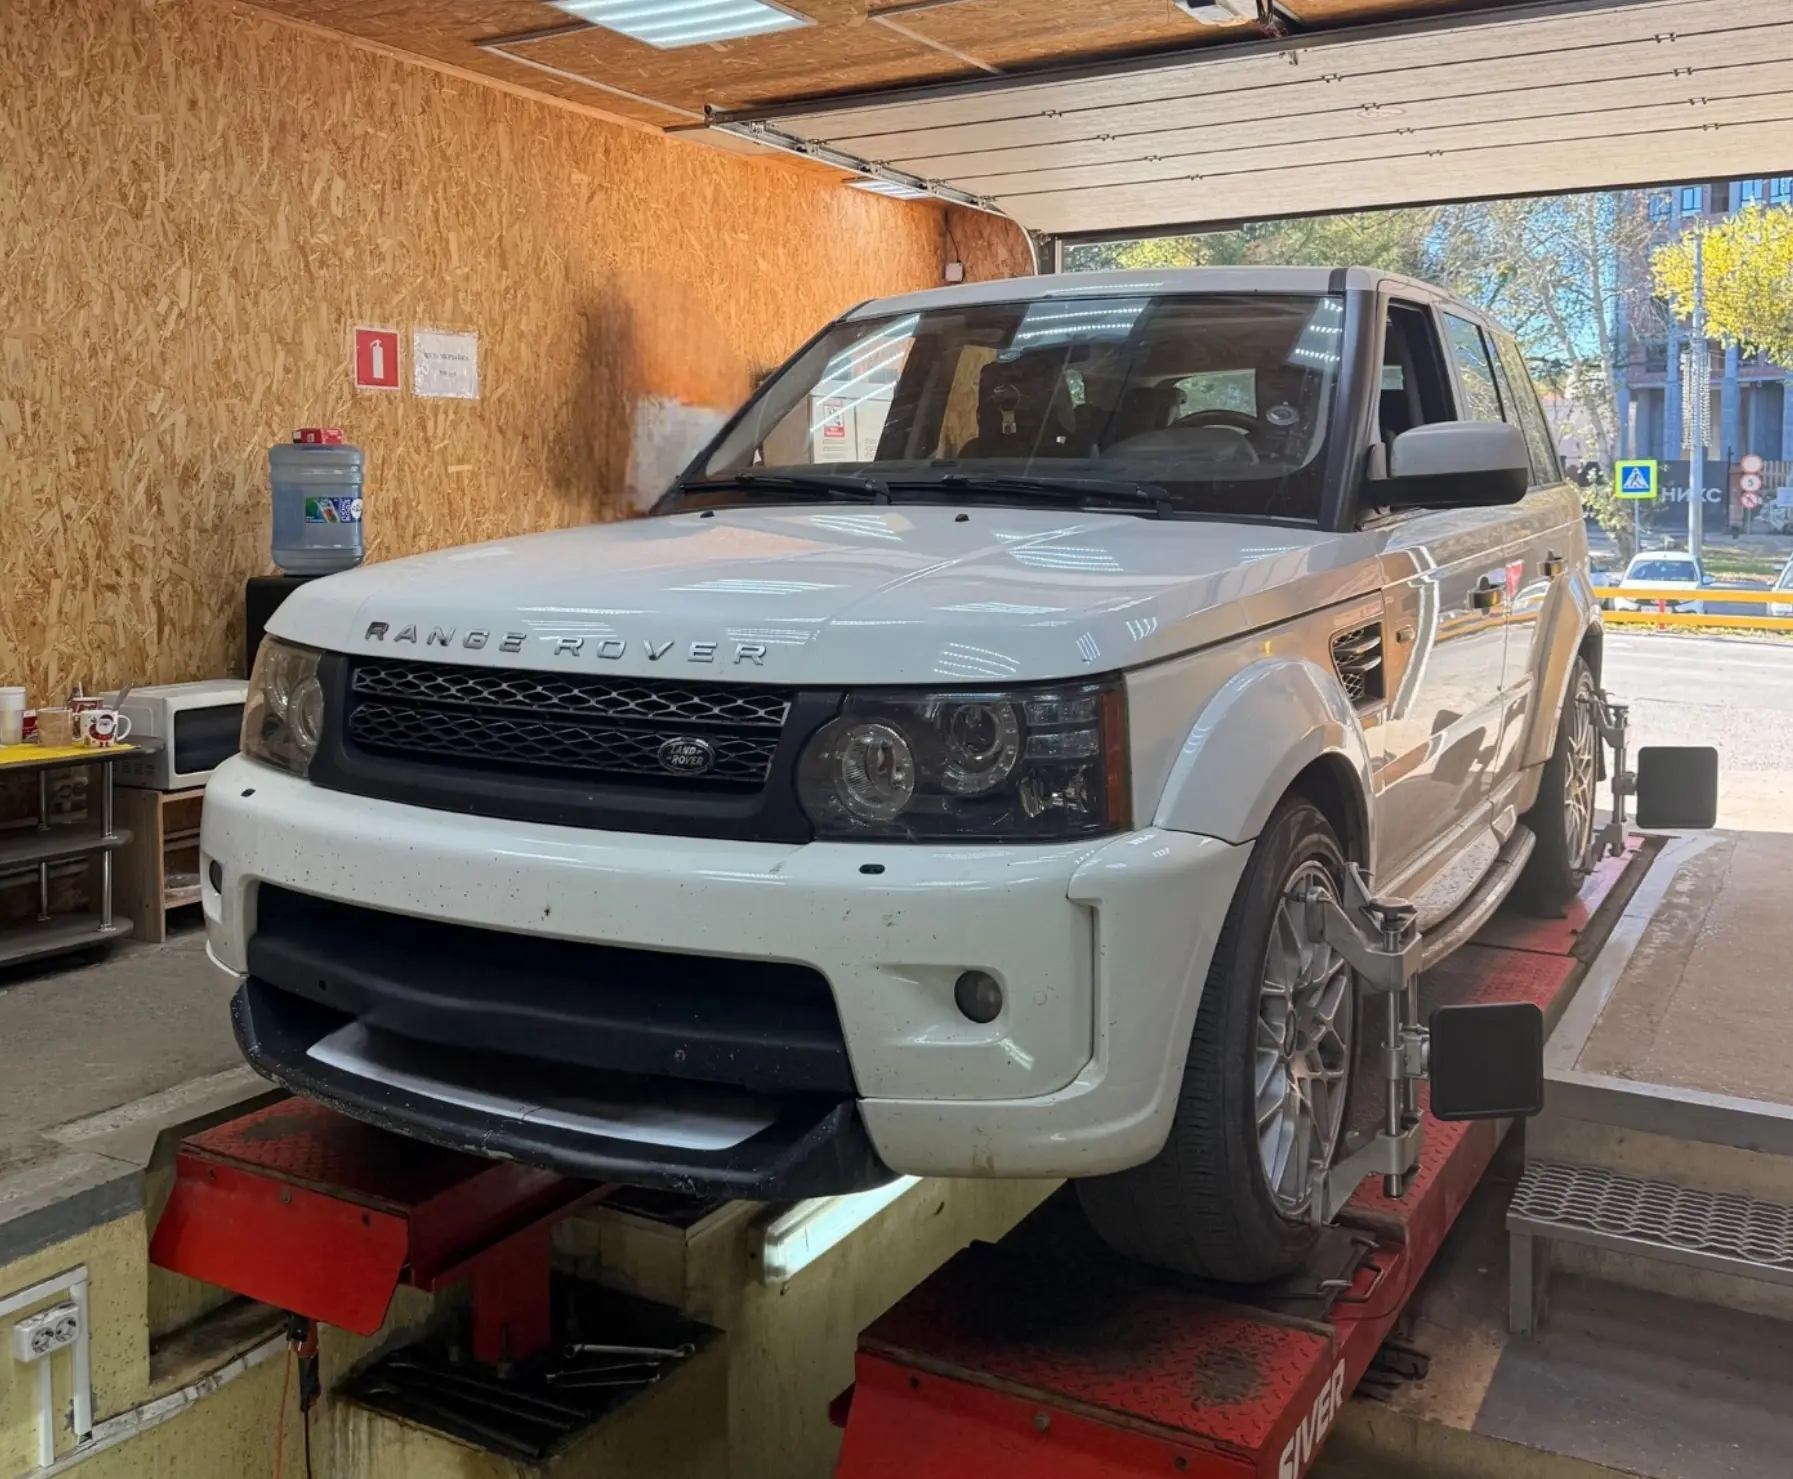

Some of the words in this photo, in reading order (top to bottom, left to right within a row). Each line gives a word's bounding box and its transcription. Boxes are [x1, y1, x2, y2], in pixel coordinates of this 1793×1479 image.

[364, 621, 527, 653] RANGE
[554, 637, 767, 666] ROVER
[670, 745, 697, 756] LAND
[671, 755, 704, 765] ROVER
